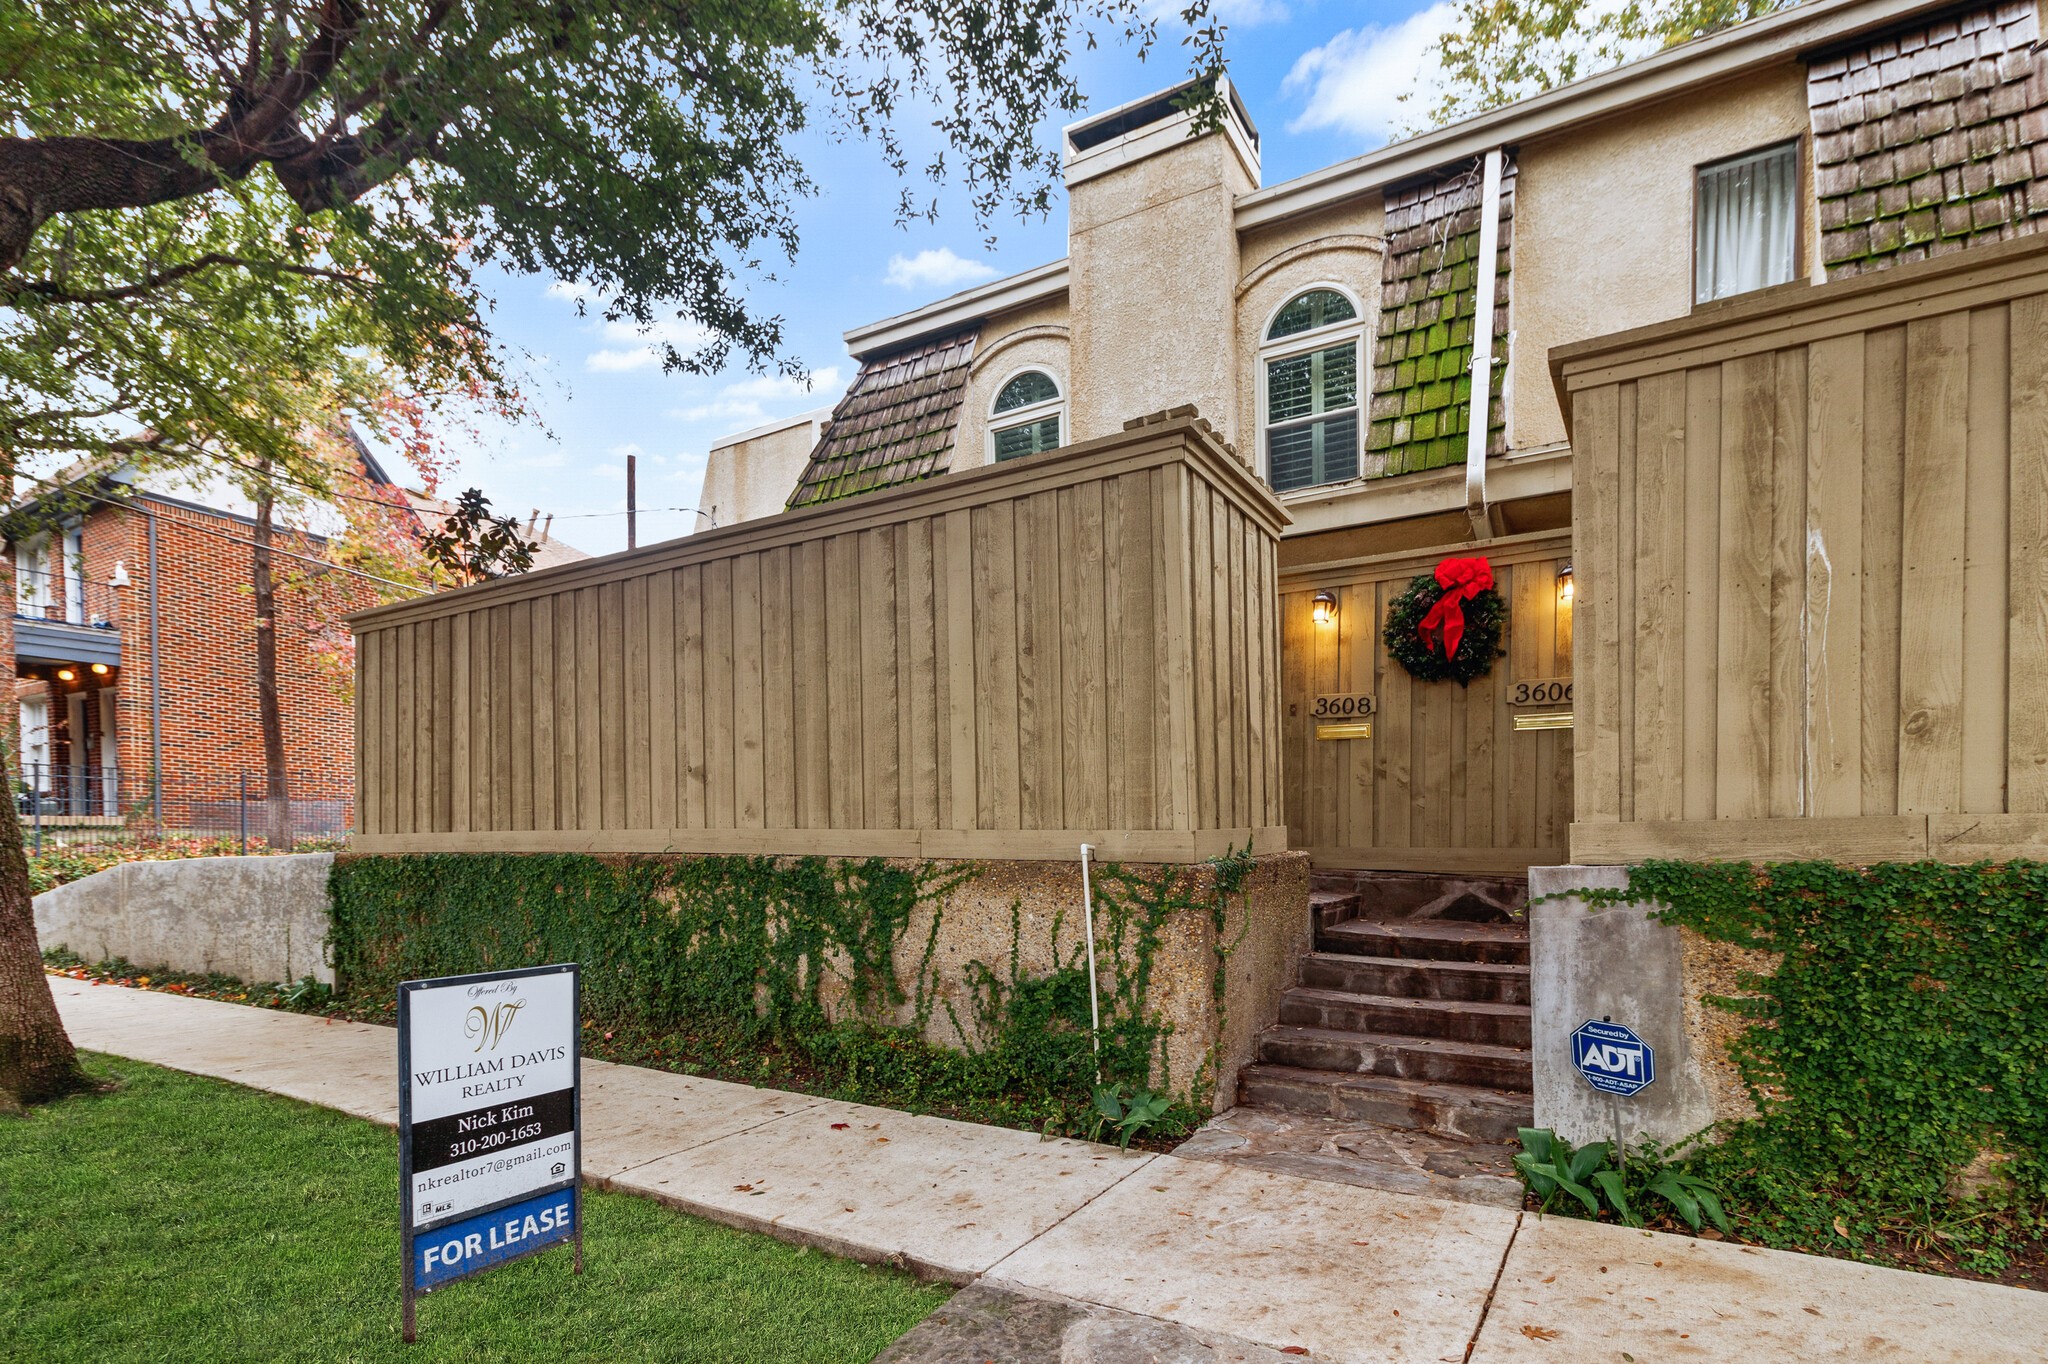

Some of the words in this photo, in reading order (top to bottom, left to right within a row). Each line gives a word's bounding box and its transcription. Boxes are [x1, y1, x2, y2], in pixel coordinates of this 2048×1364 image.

[1315, 697, 1371, 715] 3608
[467, 984, 498, 1000] Offered
[500, 980, 518, 996] By
[1587, 1026, 1618, 1038] Secured
[1619, 1031, 1630, 1040] by
[415, 1057, 503, 1087] WILLIAM
[511, 1046, 565, 1069] DAVIS
[1582, 1042, 1640, 1076] ADT
[462, 1075, 526, 1099] REALTY
[1587, 1074, 1638, 1089] 1-800-ADT-ASAP
[458, 1111, 497, 1133] Nick
[501, 1105, 534, 1126] Kim
[450, 1122, 542, 1158] 310-200-1653
[417, 1142, 572, 1193] nkrealtor7@gmail.com
[424, 1233, 483, 1274] FOR
[489, 1203, 570, 1250] LEASE
